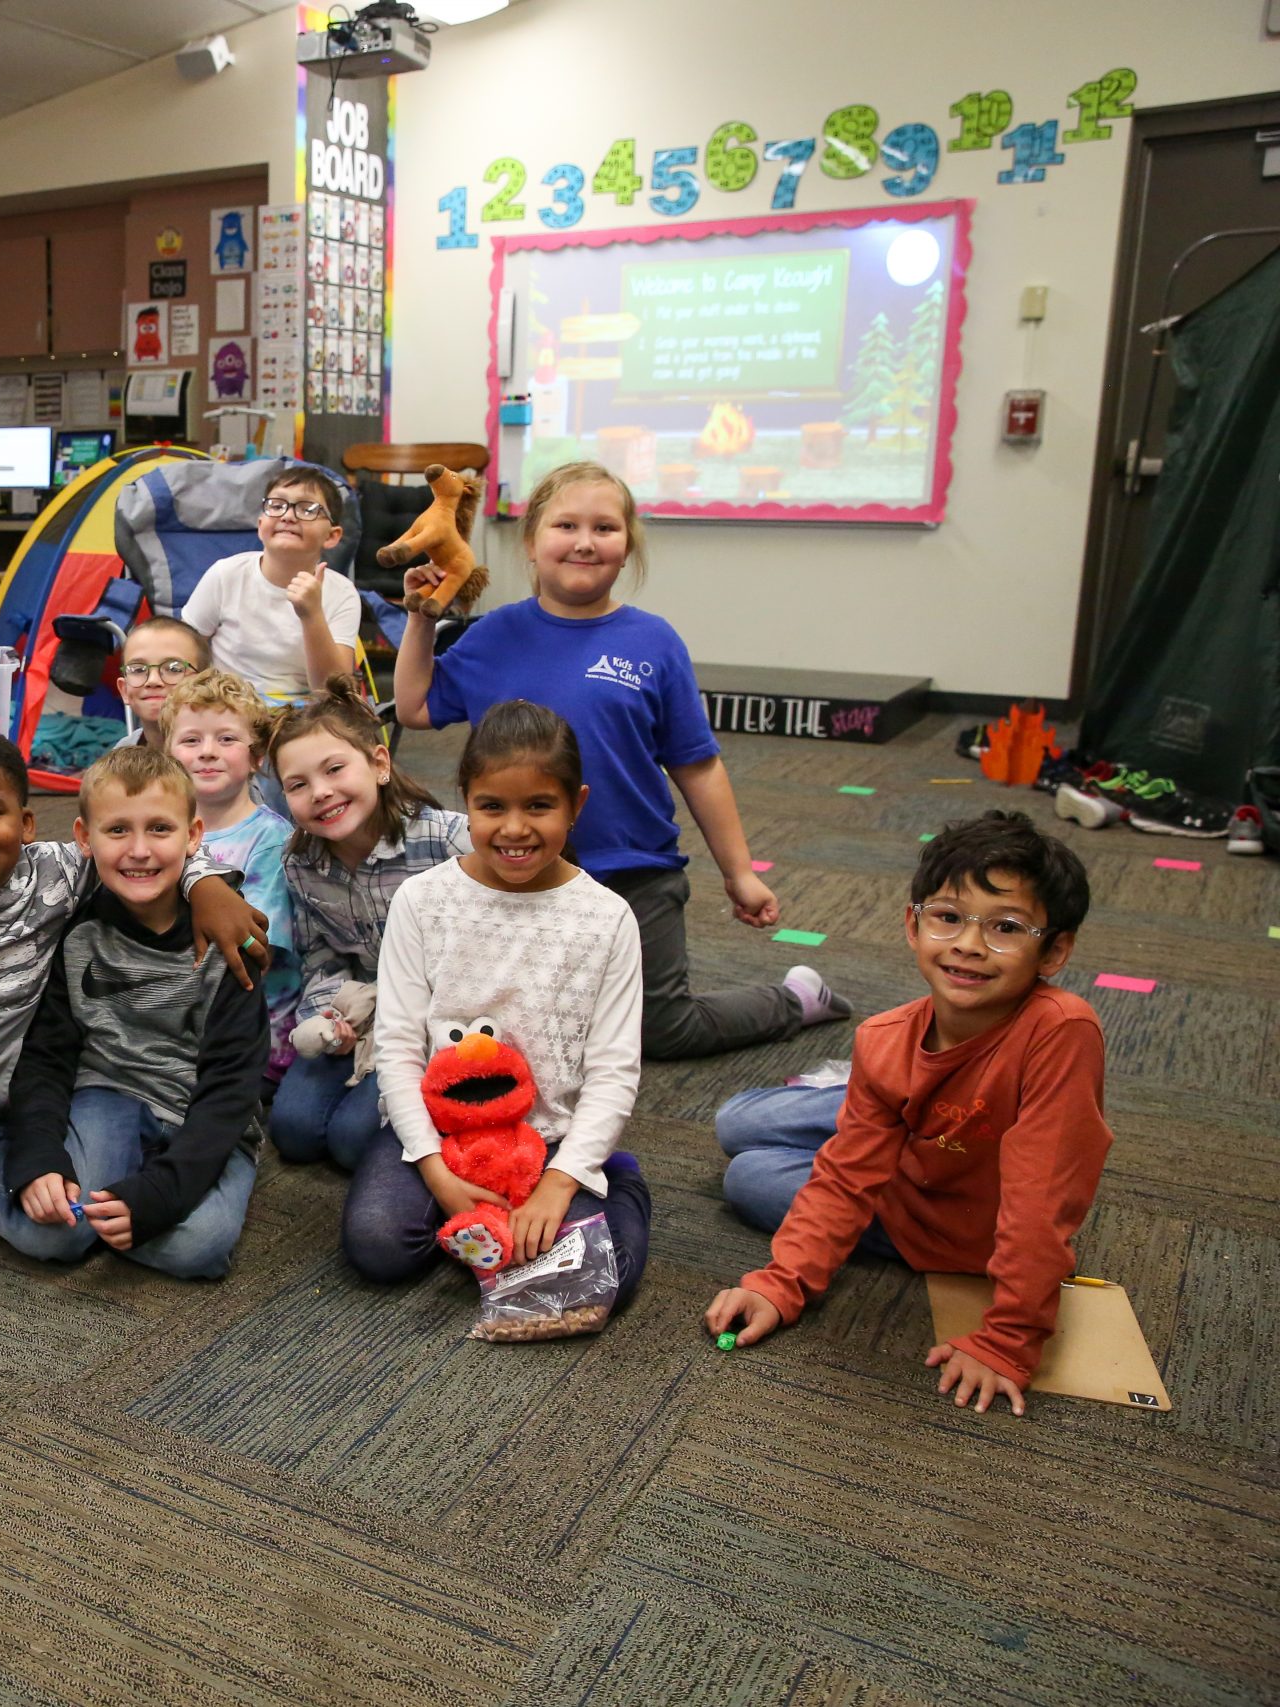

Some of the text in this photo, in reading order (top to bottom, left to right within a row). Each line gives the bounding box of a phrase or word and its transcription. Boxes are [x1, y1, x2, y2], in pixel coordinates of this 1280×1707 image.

[327, 97, 369, 150] JOB
[311, 139, 384, 200] BOARD
[436, 67, 1137, 249] 1 2 3 4 5 6 7 8 9 10 11 12
[630, 275, 695, 297] Welcome
[702, 272, 717, 293] to
[612, 656, 634, 671] Kids
[620, 669, 642, 685] Club
[781, 698, 831, 738] THE
[549, 1244, 568, 1257] snack
